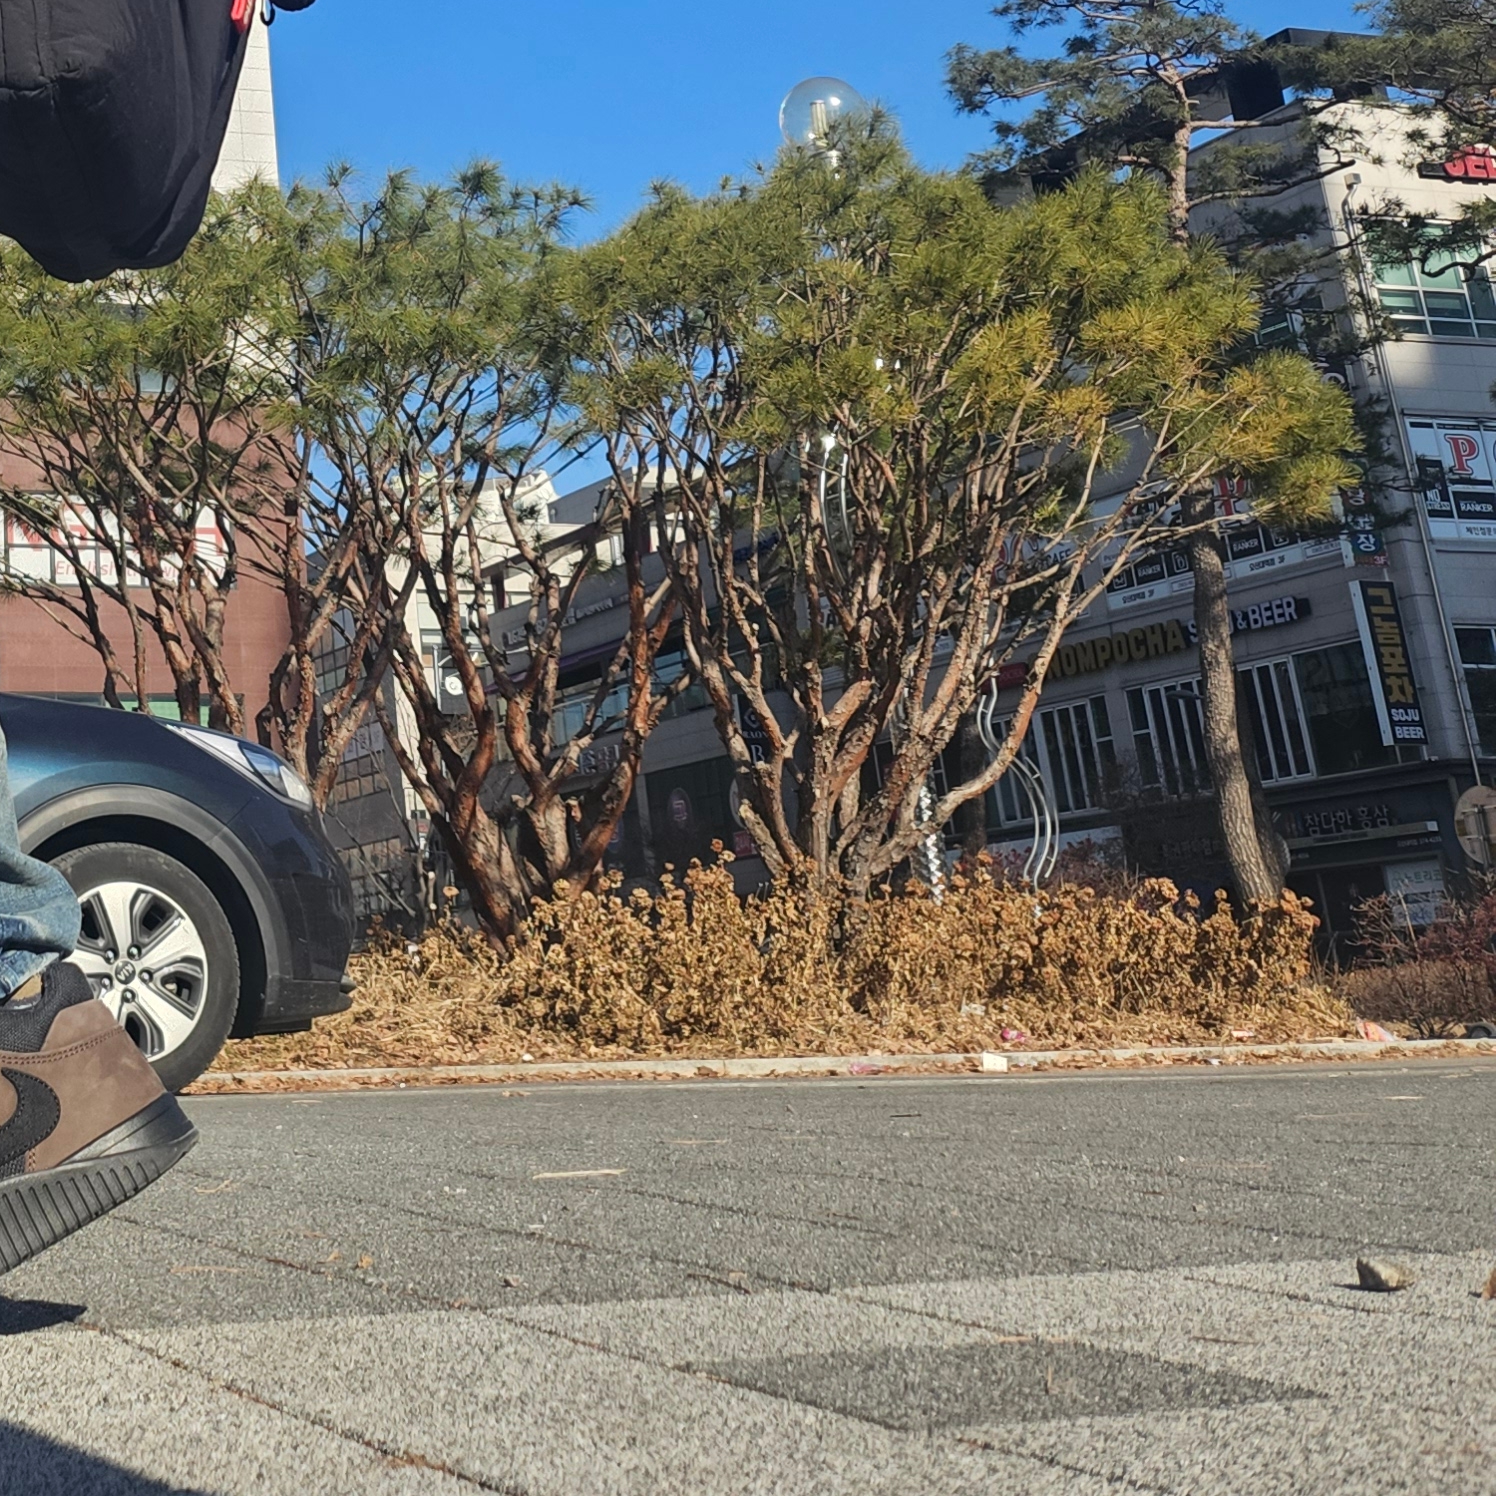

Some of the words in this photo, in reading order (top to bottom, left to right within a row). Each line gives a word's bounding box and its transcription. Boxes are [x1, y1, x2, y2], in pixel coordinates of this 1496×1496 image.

[1029, 618, 1187, 681] NOMPOCHA
[1247, 596, 1298, 630] BEER
[1391, 708, 1420, 721] SOJU
[1394, 726, 1425, 739] BEER
[1358, 804, 1390, 830] 홍삼
